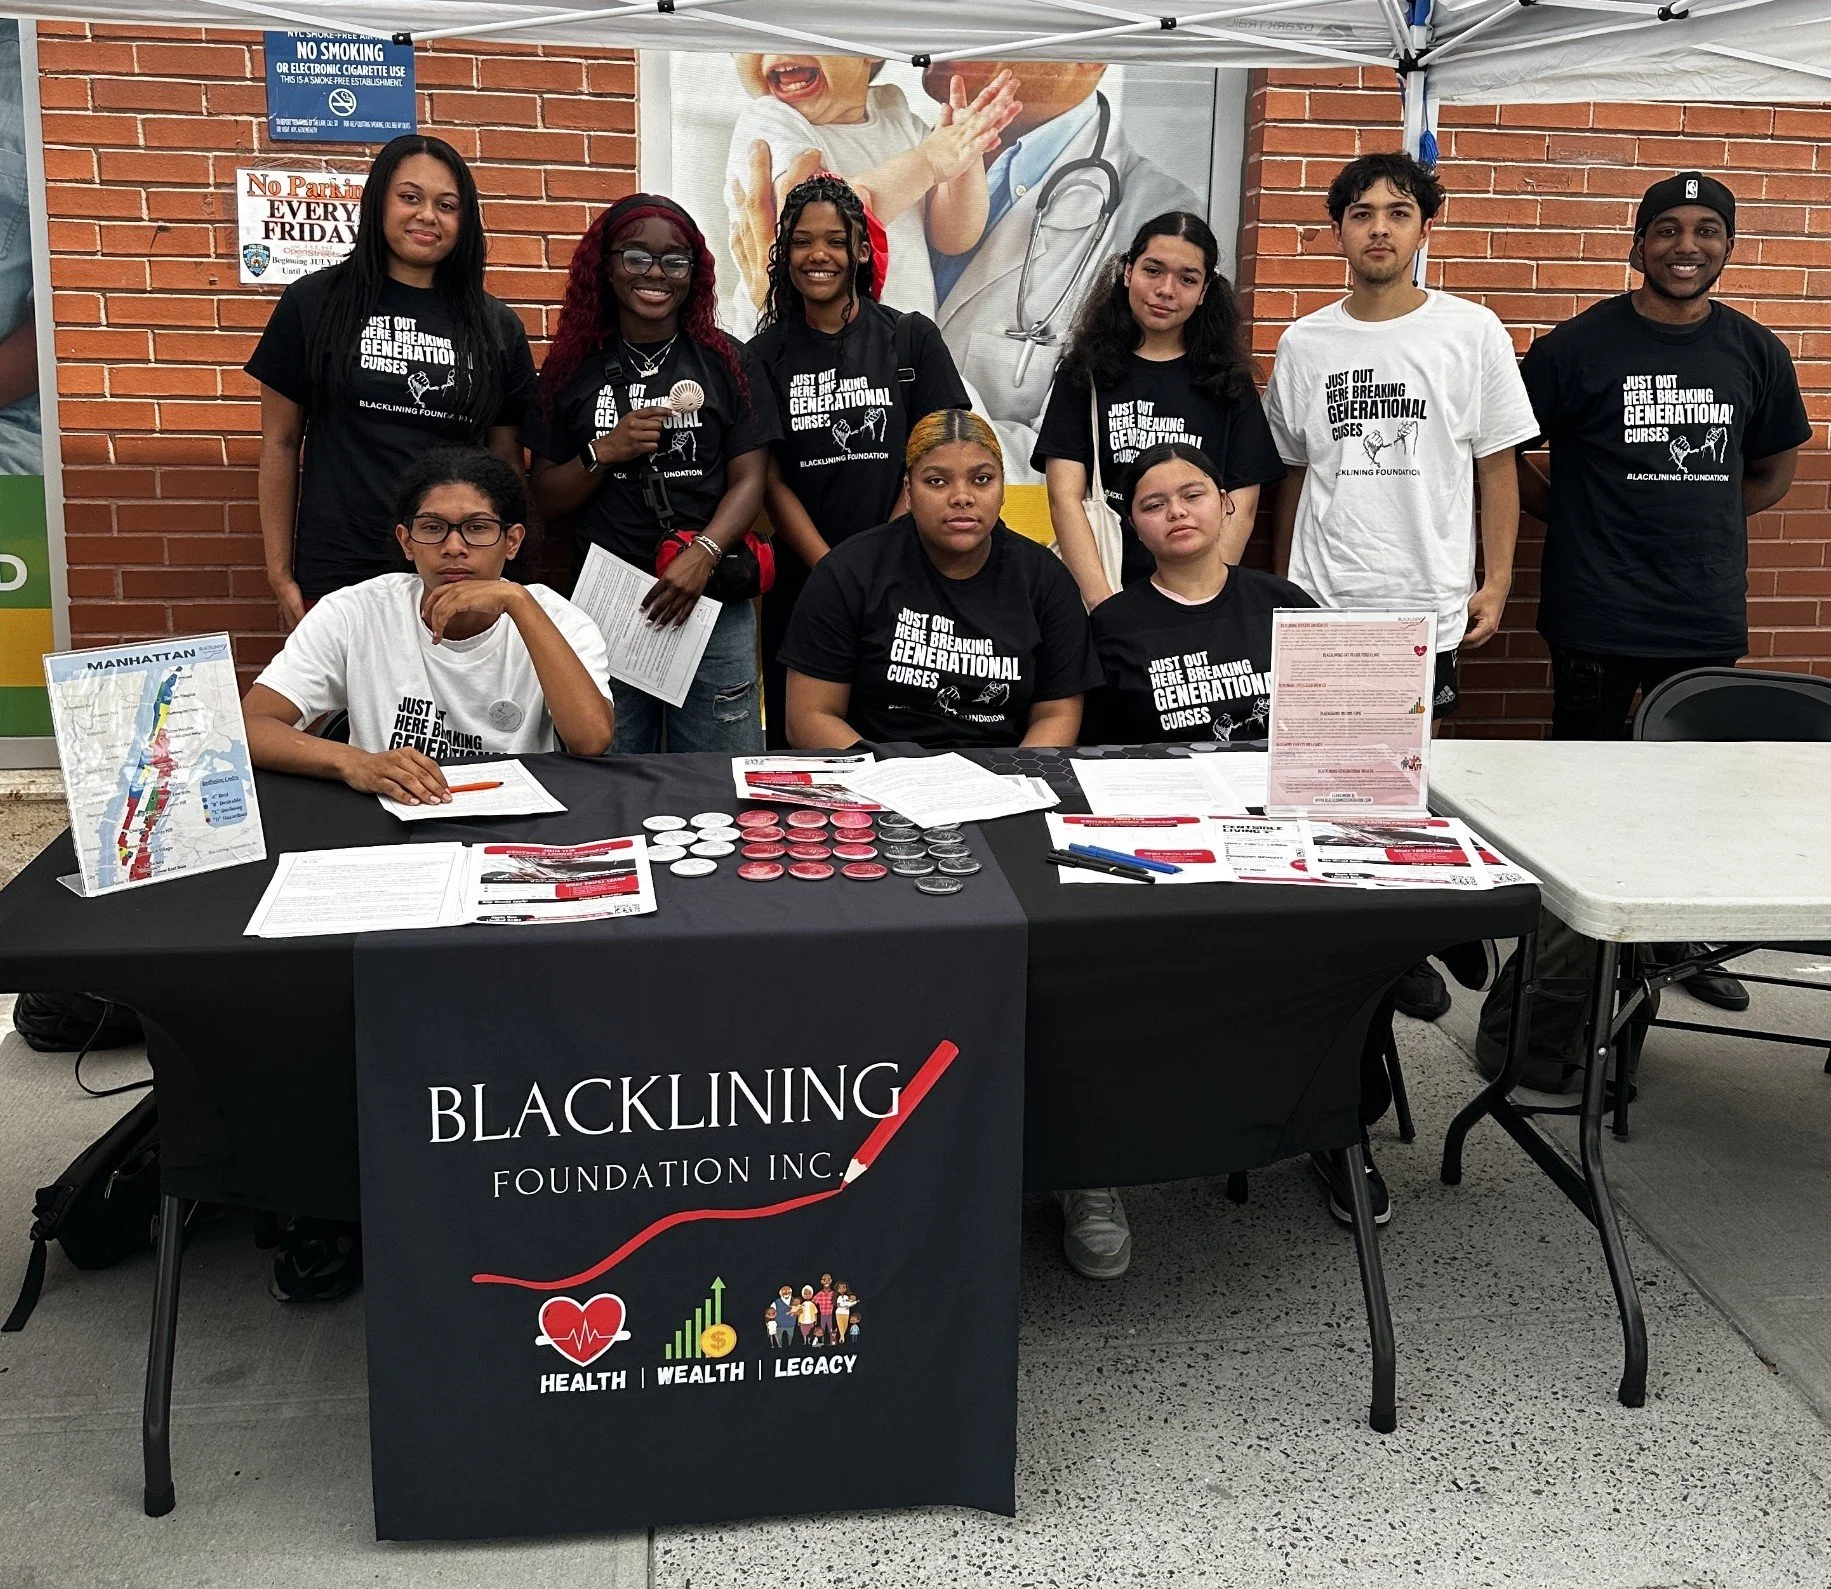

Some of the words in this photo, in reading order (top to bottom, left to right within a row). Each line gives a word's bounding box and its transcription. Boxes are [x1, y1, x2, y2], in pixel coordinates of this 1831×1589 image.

[296, 42, 317, 60] NO
[320, 43, 384, 61] SMOKING
[276, 62, 288, 73] OR
[291, 63, 341, 75] ELECTRONIC
[343, 65, 387, 77] CIGARETTE
[390, 67, 406, 77] USE
[280, 75, 295, 84] THIS
[296, 76, 303, 84] IS
[310, 77, 350, 85] SMOKE-FREE
[247, 173, 282, 196] No
[287, 175, 364, 199] Parkin
[267, 199, 358, 222] EVERY
[262, 220, 359, 244] FRIDAY
[272, 257, 308, 266] Beginning
[310, 258, 333, 266] JULY
[364, 316, 391, 329] UST
[394, 316, 416, 331] OUT
[361, 326, 392, 340] HERE
[395, 331, 453, 350] BREAKING
[361, 355, 408, 375] CURSES
[789, 386, 816, 397] HERE
[818, 376, 868, 396] BREAKING
[790, 373, 816, 388] JUST
[818, 368, 836, 385] OUT
[1325, 371, 1349, 390] JUST
[1352, 368, 1374, 384] OUT
[1622, 375, 1652, 390] JUST
[1655, 374, 1678, 389] OUT
[789, 387, 893, 415] GENERATIONAL
[1326, 386, 1349, 405] HERE
[1352, 382, 1406, 400] BREAKING
[1623, 389, 1654, 406] HERE
[1656, 388, 1714, 404] BREAKING
[360, 400, 418, 414] BLACKLINING
[1108, 401, 1135, 418] JUST
[1136, 400, 1155, 416] OUT
[1327, 398, 1427, 425] GENERATIONAL
[791, 413, 831, 431] CURSES
[1108, 414, 1136, 432] HERE
[1137, 414, 1185, 433] BREAKING
[1624, 426, 1669, 443] CURSES
[800, 454, 847, 468] BLACKLINING
[847, 452, 889, 461] FOUNDATION
[663, 469, 703, 478] UNDATION
[1335, 469, 1374, 479] CKLINING
[1627, 472, 1682, 481] BLACKLINING
[1683, 473, 1730, 482] FOUNDATION
[898, 606, 929, 629] JUST
[931, 615, 955, 635] OUT
[894, 621, 927, 644] HERE
[929, 631, 994, 656] BREAKING
[87, 649, 196, 670] MANHATTAN
[890, 638, 1022, 681] GENERATIONAL
[1148, 655, 1180, 674] JUST
[1183, 651, 1208, 668] OUT
[887, 664, 940, 689] CURSES
[1150, 670, 1185, 689] HERE
[1186, 659, 1254, 683] BREAKING
[1153, 671, 1272, 712] GENERATION
[398, 697, 433, 718] JUST
[394, 713, 430, 736] HERE
[1160, 706, 1212, 731] CURSES
[428, 1062, 902, 1143] BLACKLINING
[494, 1156, 750, 1198] FOUNDATION
[769, 1151, 844, 1181] INC.
[540, 1370, 627, 1394] HEALTH
[657, 1361, 745, 1386] WEALTH
[774, 1354, 857, 1379] LEGACY
